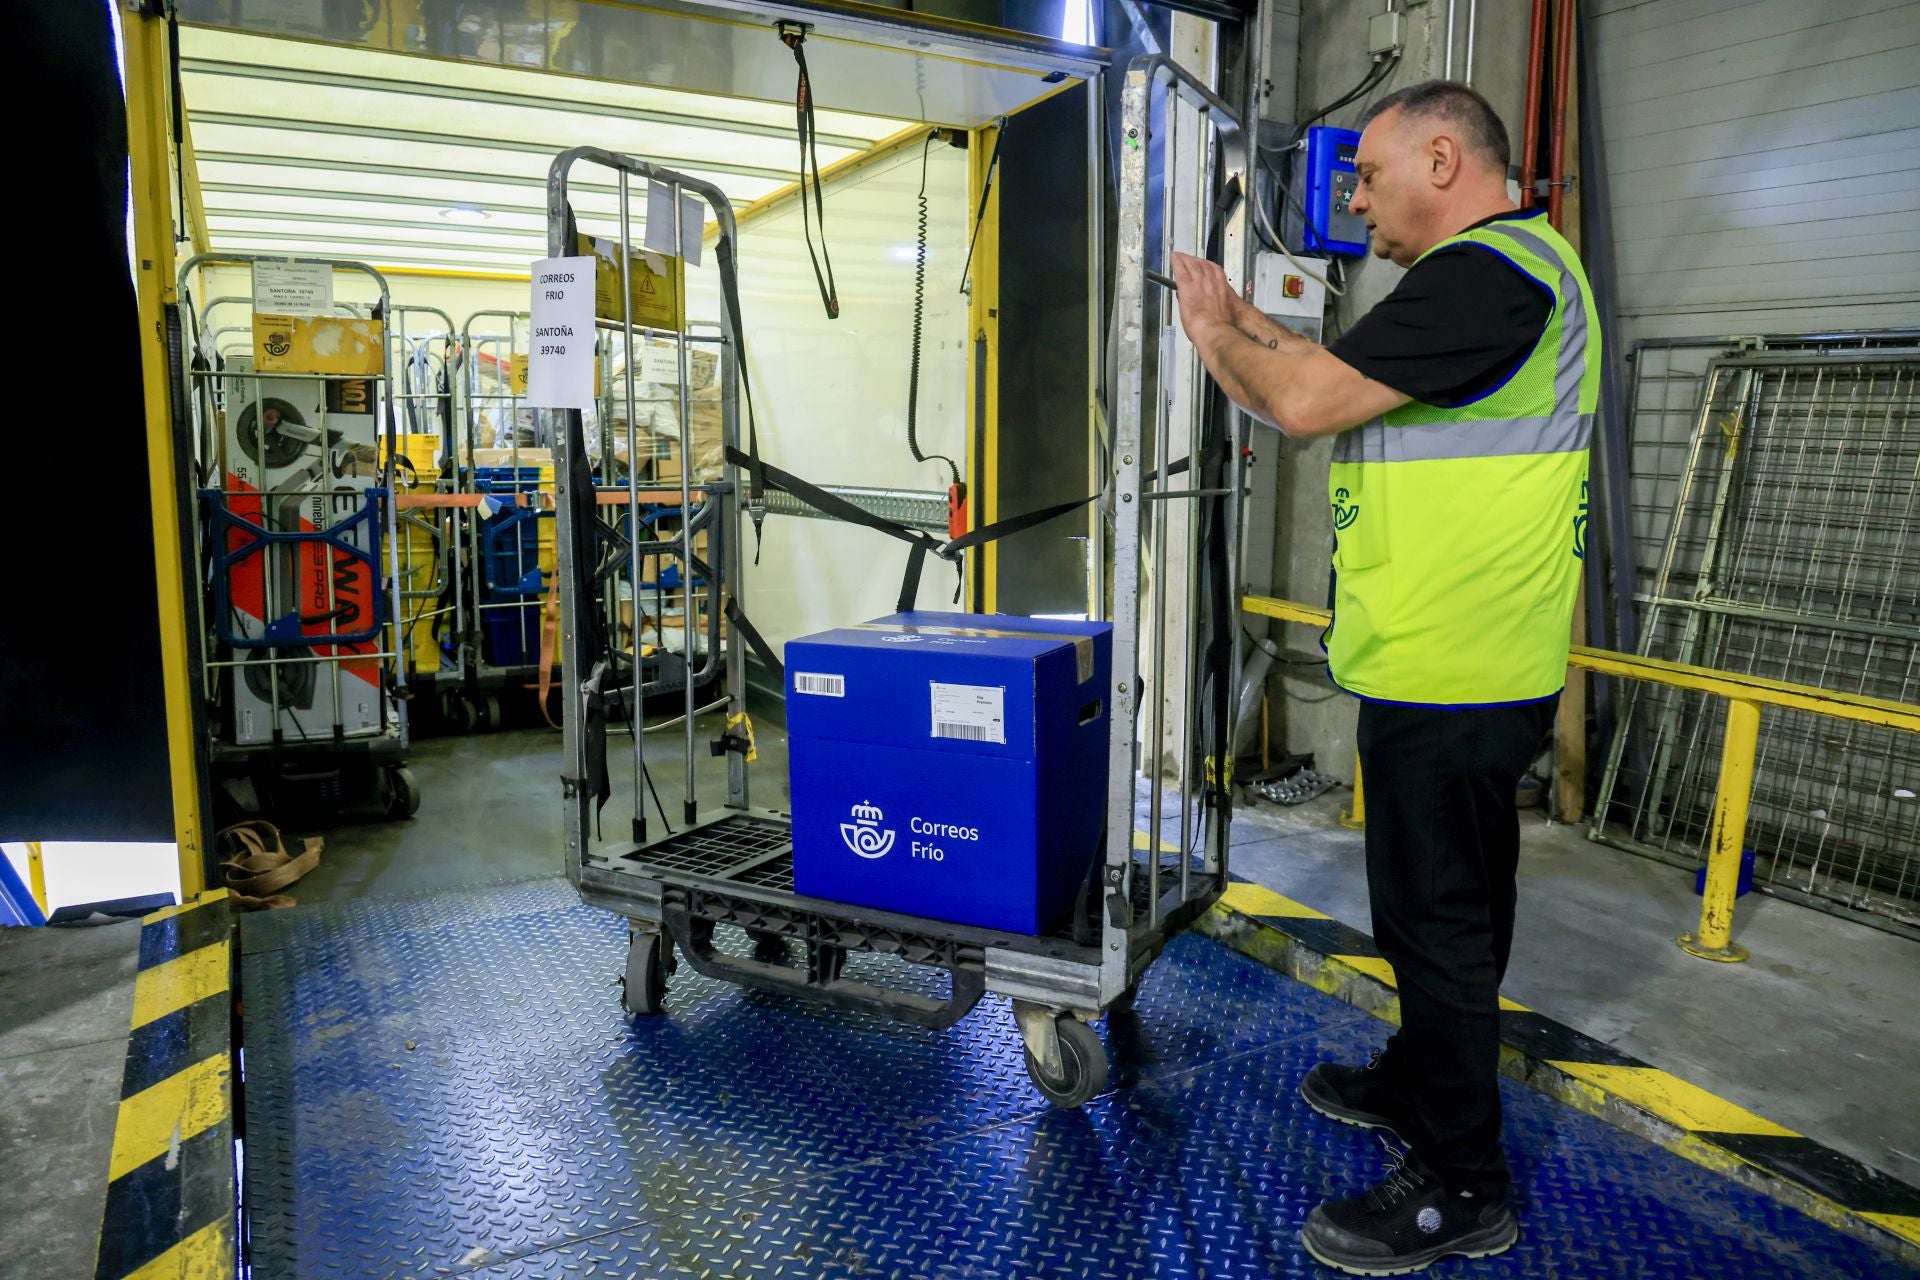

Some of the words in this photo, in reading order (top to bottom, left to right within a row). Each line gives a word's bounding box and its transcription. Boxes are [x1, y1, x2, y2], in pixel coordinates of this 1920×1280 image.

[540, 273, 575, 284] CORREOS
[545, 290, 564, 300] FRIO
[536, 325, 574, 337] SANTOÑA
[540, 345, 566, 355] 39740
[237, 467, 247, 479] 55
[312, 496, 325, 534] ninebo
[314, 569, 325, 610] PRO
[910, 816, 979, 841] Correos
[911, 841, 944, 862] Frío
